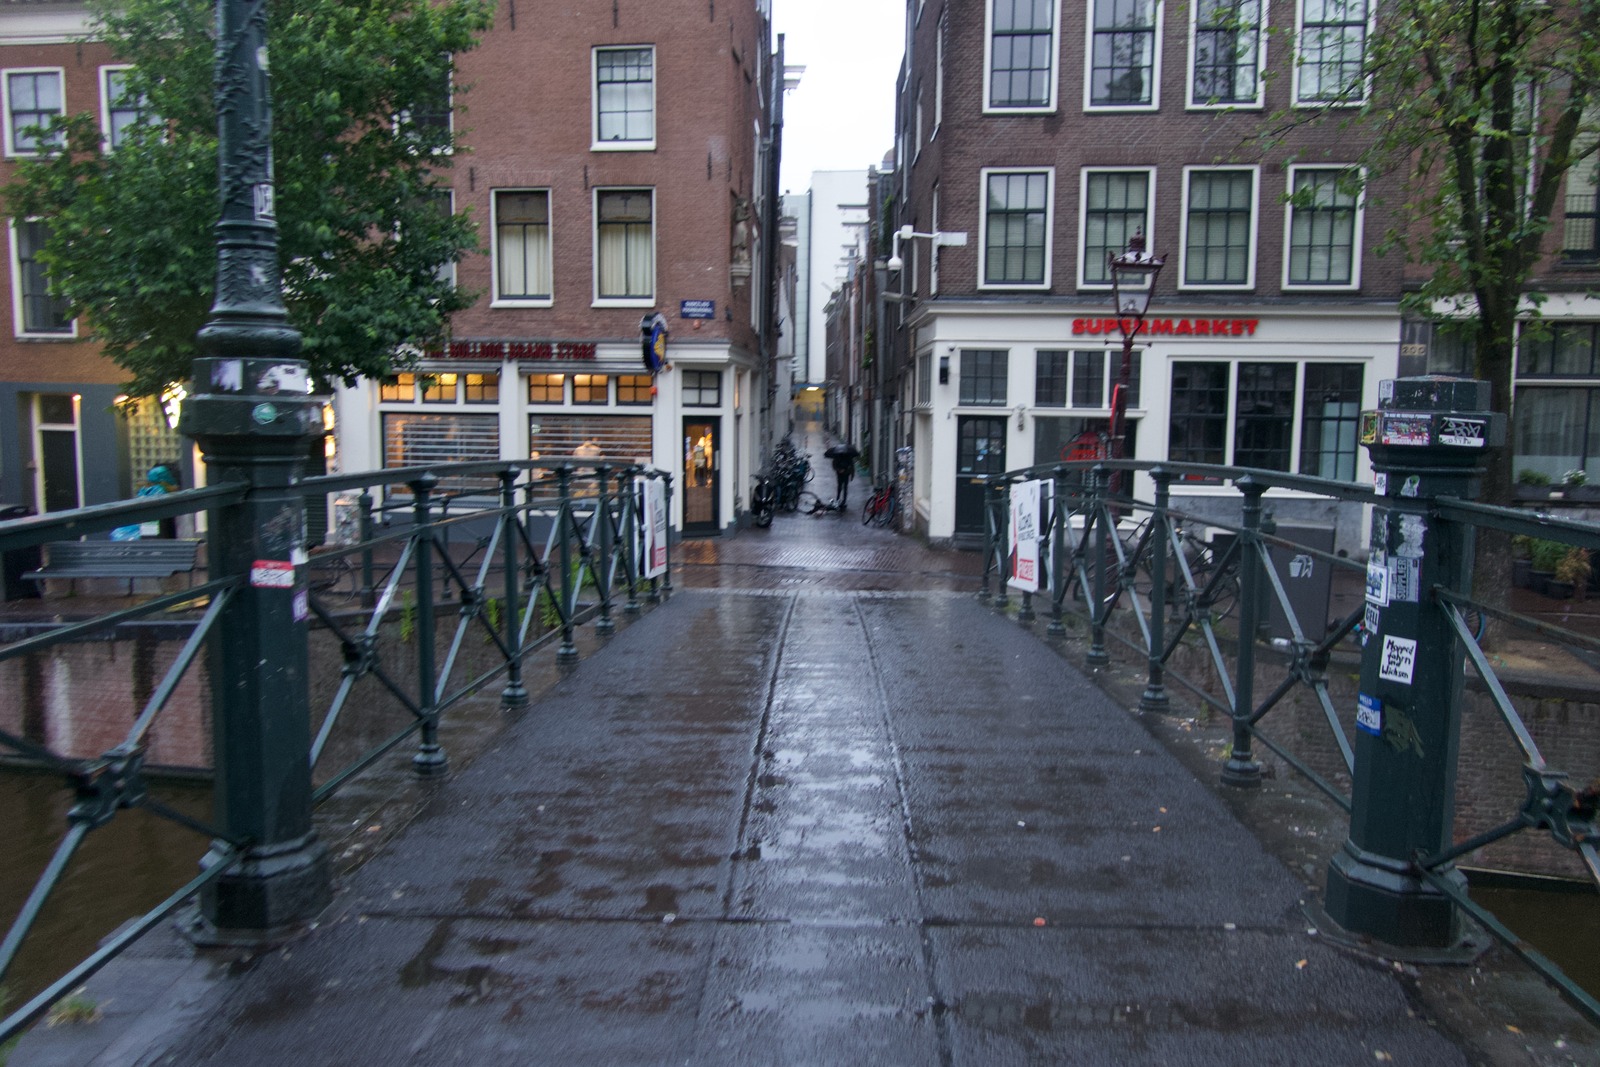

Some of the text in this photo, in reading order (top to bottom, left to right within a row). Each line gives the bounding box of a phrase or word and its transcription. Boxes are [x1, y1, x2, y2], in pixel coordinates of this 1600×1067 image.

[1072, 318, 1259, 335] SUPERMARKET
[448, 343, 505, 359] BULLDOG
[508, 342, 552, 359] BRAND
[557, 342, 597, 360] STORE
